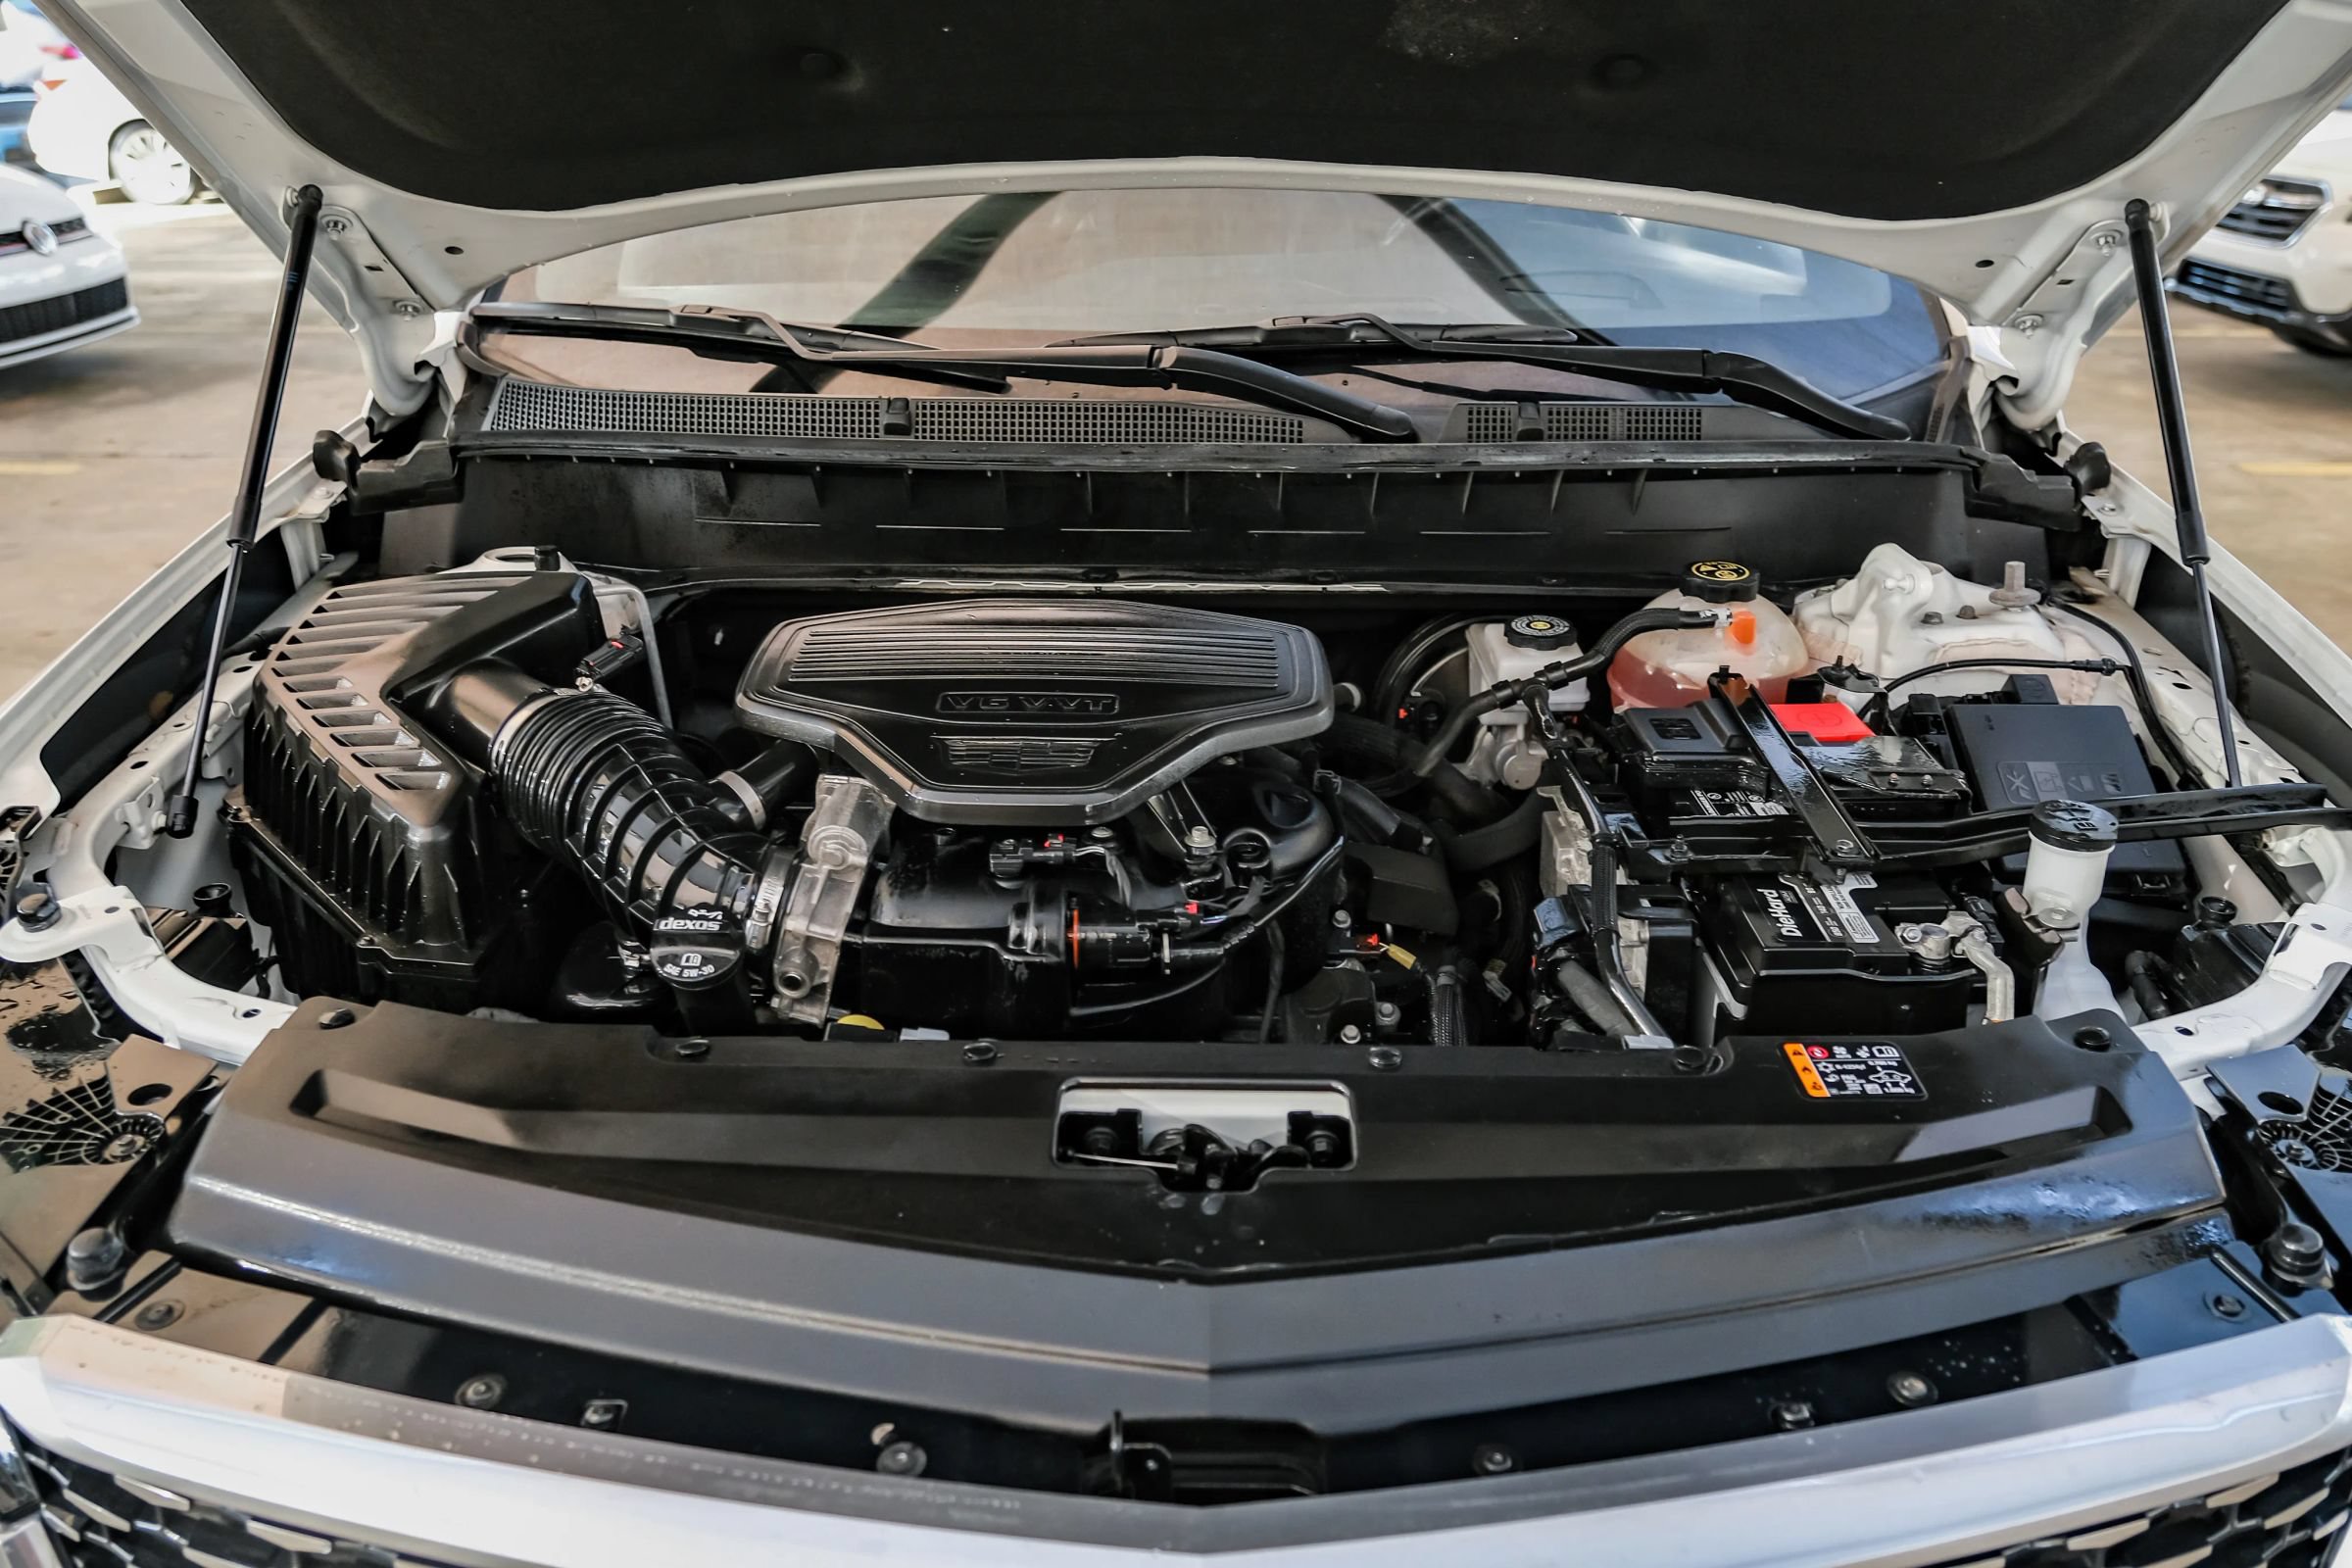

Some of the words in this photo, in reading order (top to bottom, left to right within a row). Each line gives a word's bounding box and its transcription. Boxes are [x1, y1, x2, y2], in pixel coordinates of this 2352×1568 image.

[947, 695, 1009, 710] V6
[1019, 695, 1113, 711] VVT
[1756, 888, 1803, 938] DieHard
[659, 916, 723, 931] dexos
[662, 962, 682, 977] SAE
[682, 964, 715, 978] 5W-30
